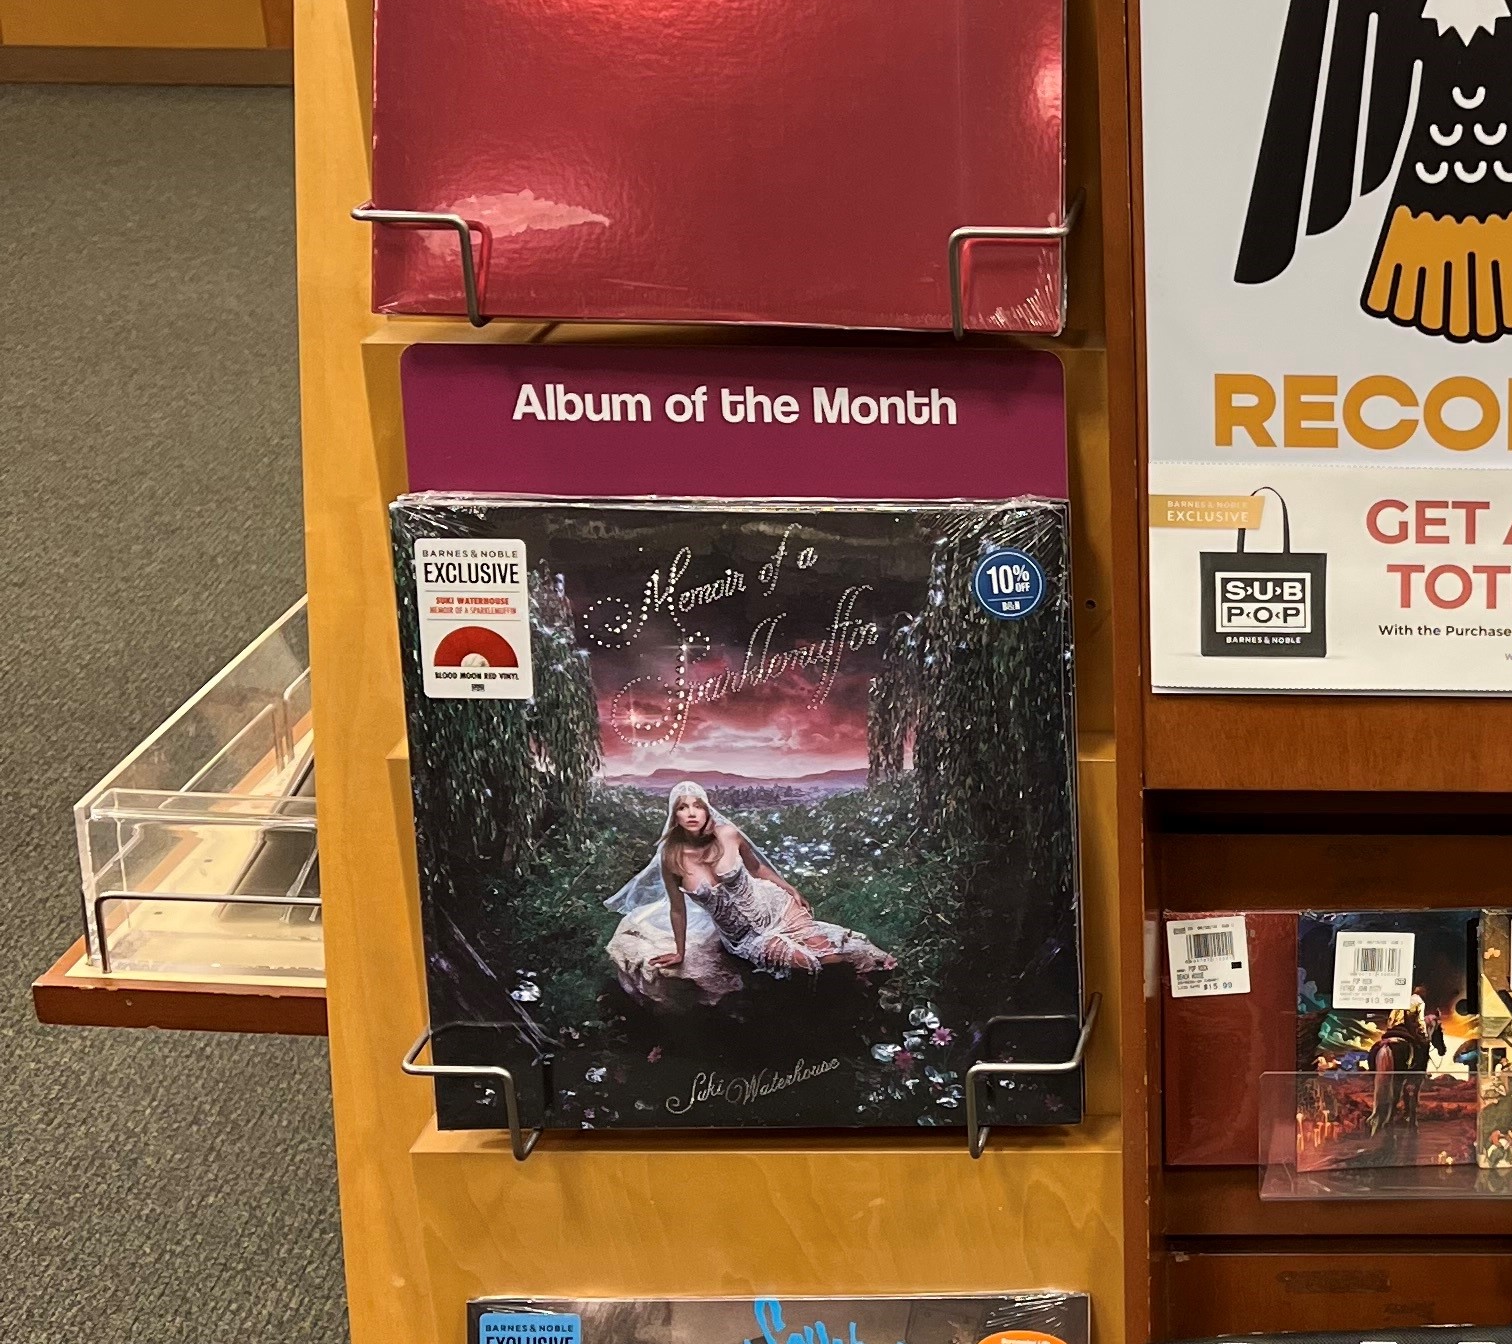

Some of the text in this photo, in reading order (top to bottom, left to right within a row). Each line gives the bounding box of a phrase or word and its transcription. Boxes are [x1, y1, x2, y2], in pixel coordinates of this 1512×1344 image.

[511, 382, 958, 426] Album of the Month
[1167, 510, 1249, 523] EXCLUSIVE
[1365, 498, 1491, 547] GET
[422, 549, 518, 558] BARNES NOBLE
[424, 562, 520, 584] EXCLUSIVE
[985, 563, 1031, 595] 10%
[1014, 581, 1031, 593] OFF
[1378, 623, 1413, 637] With
[1417, 624, 1442, 637] the
[1445, 625, 1512, 638] Purchase
[665, 1057, 841, 1115] Suki Waterhouse
[485, 1324, 574, 1333] BARNES NOBLE
